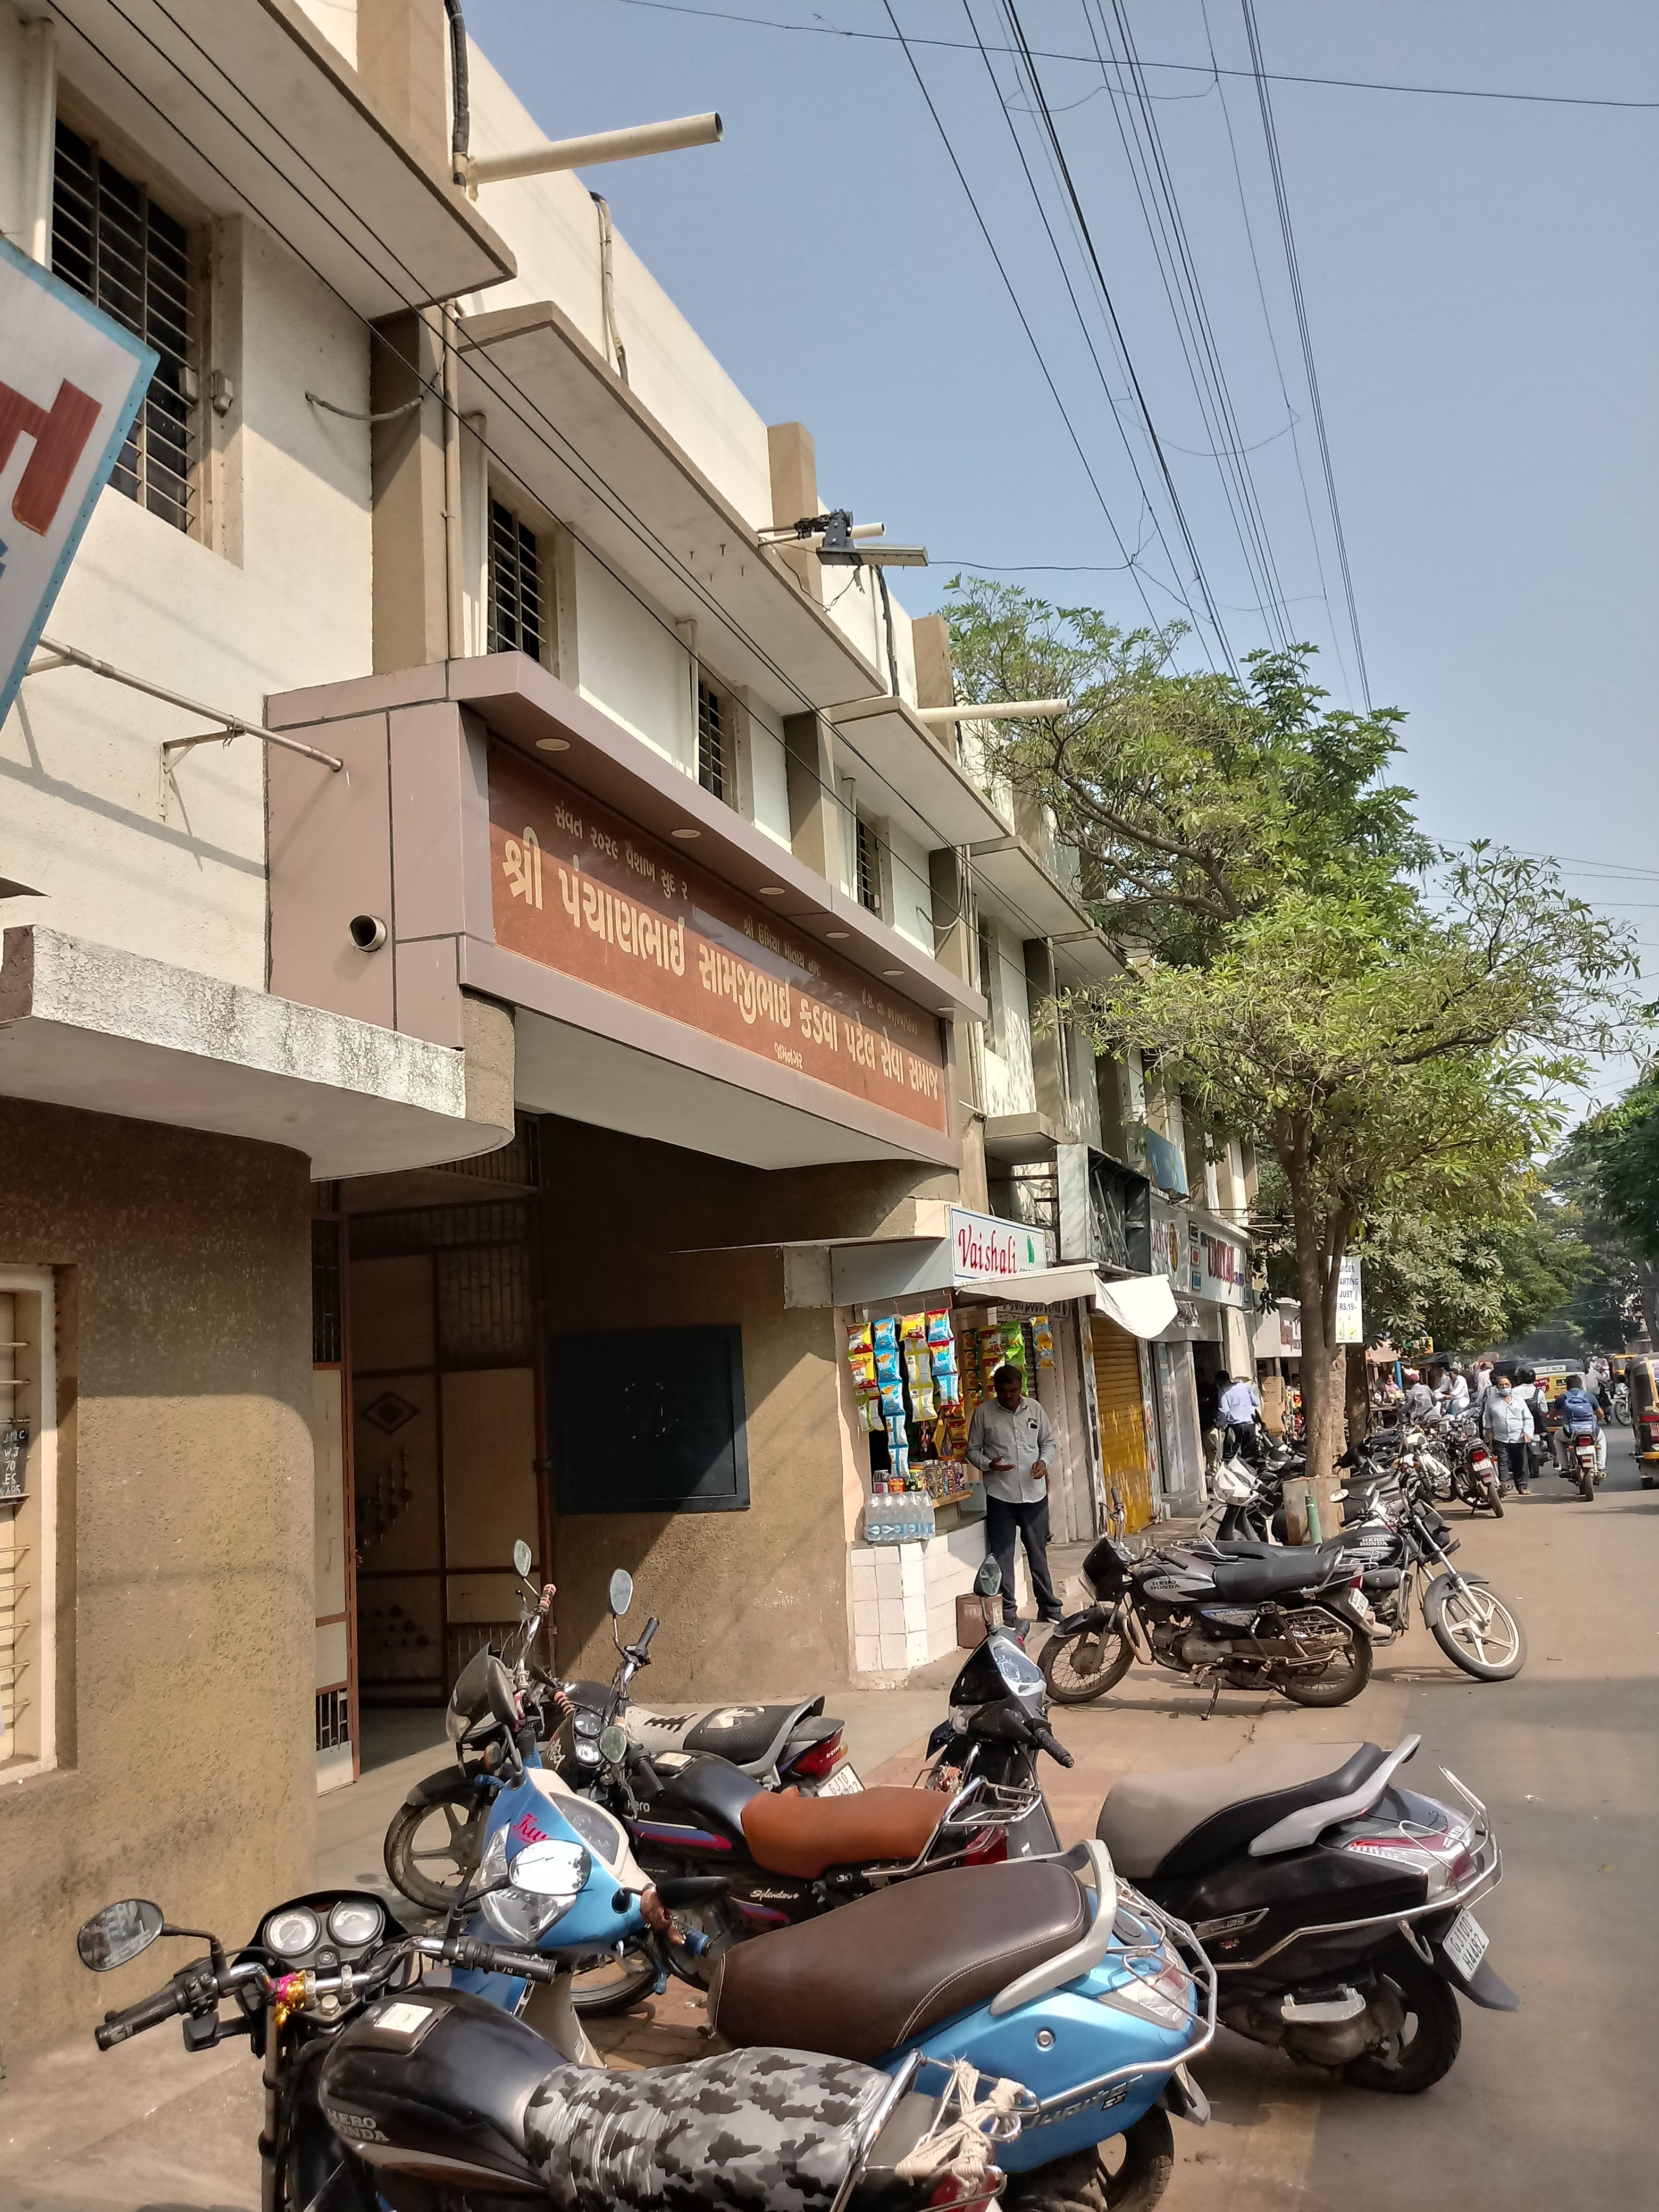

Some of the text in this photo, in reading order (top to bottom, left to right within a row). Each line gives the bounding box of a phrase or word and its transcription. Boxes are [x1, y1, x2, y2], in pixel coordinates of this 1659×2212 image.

[501, 825, 543, 911] શ્રી
[699, 942, 792, 1028] સામજીભાઈ
[800, 998, 839, 1052] કડવા
[844, 1010, 876, 1071] પટેલ
[881, 1025, 905, 1084] સેવા
[909, 1055, 939, 1101] સમાજ
[957, 1224, 1018, 1274] Vaishali
[326, 2108, 377, 2129] HERO
